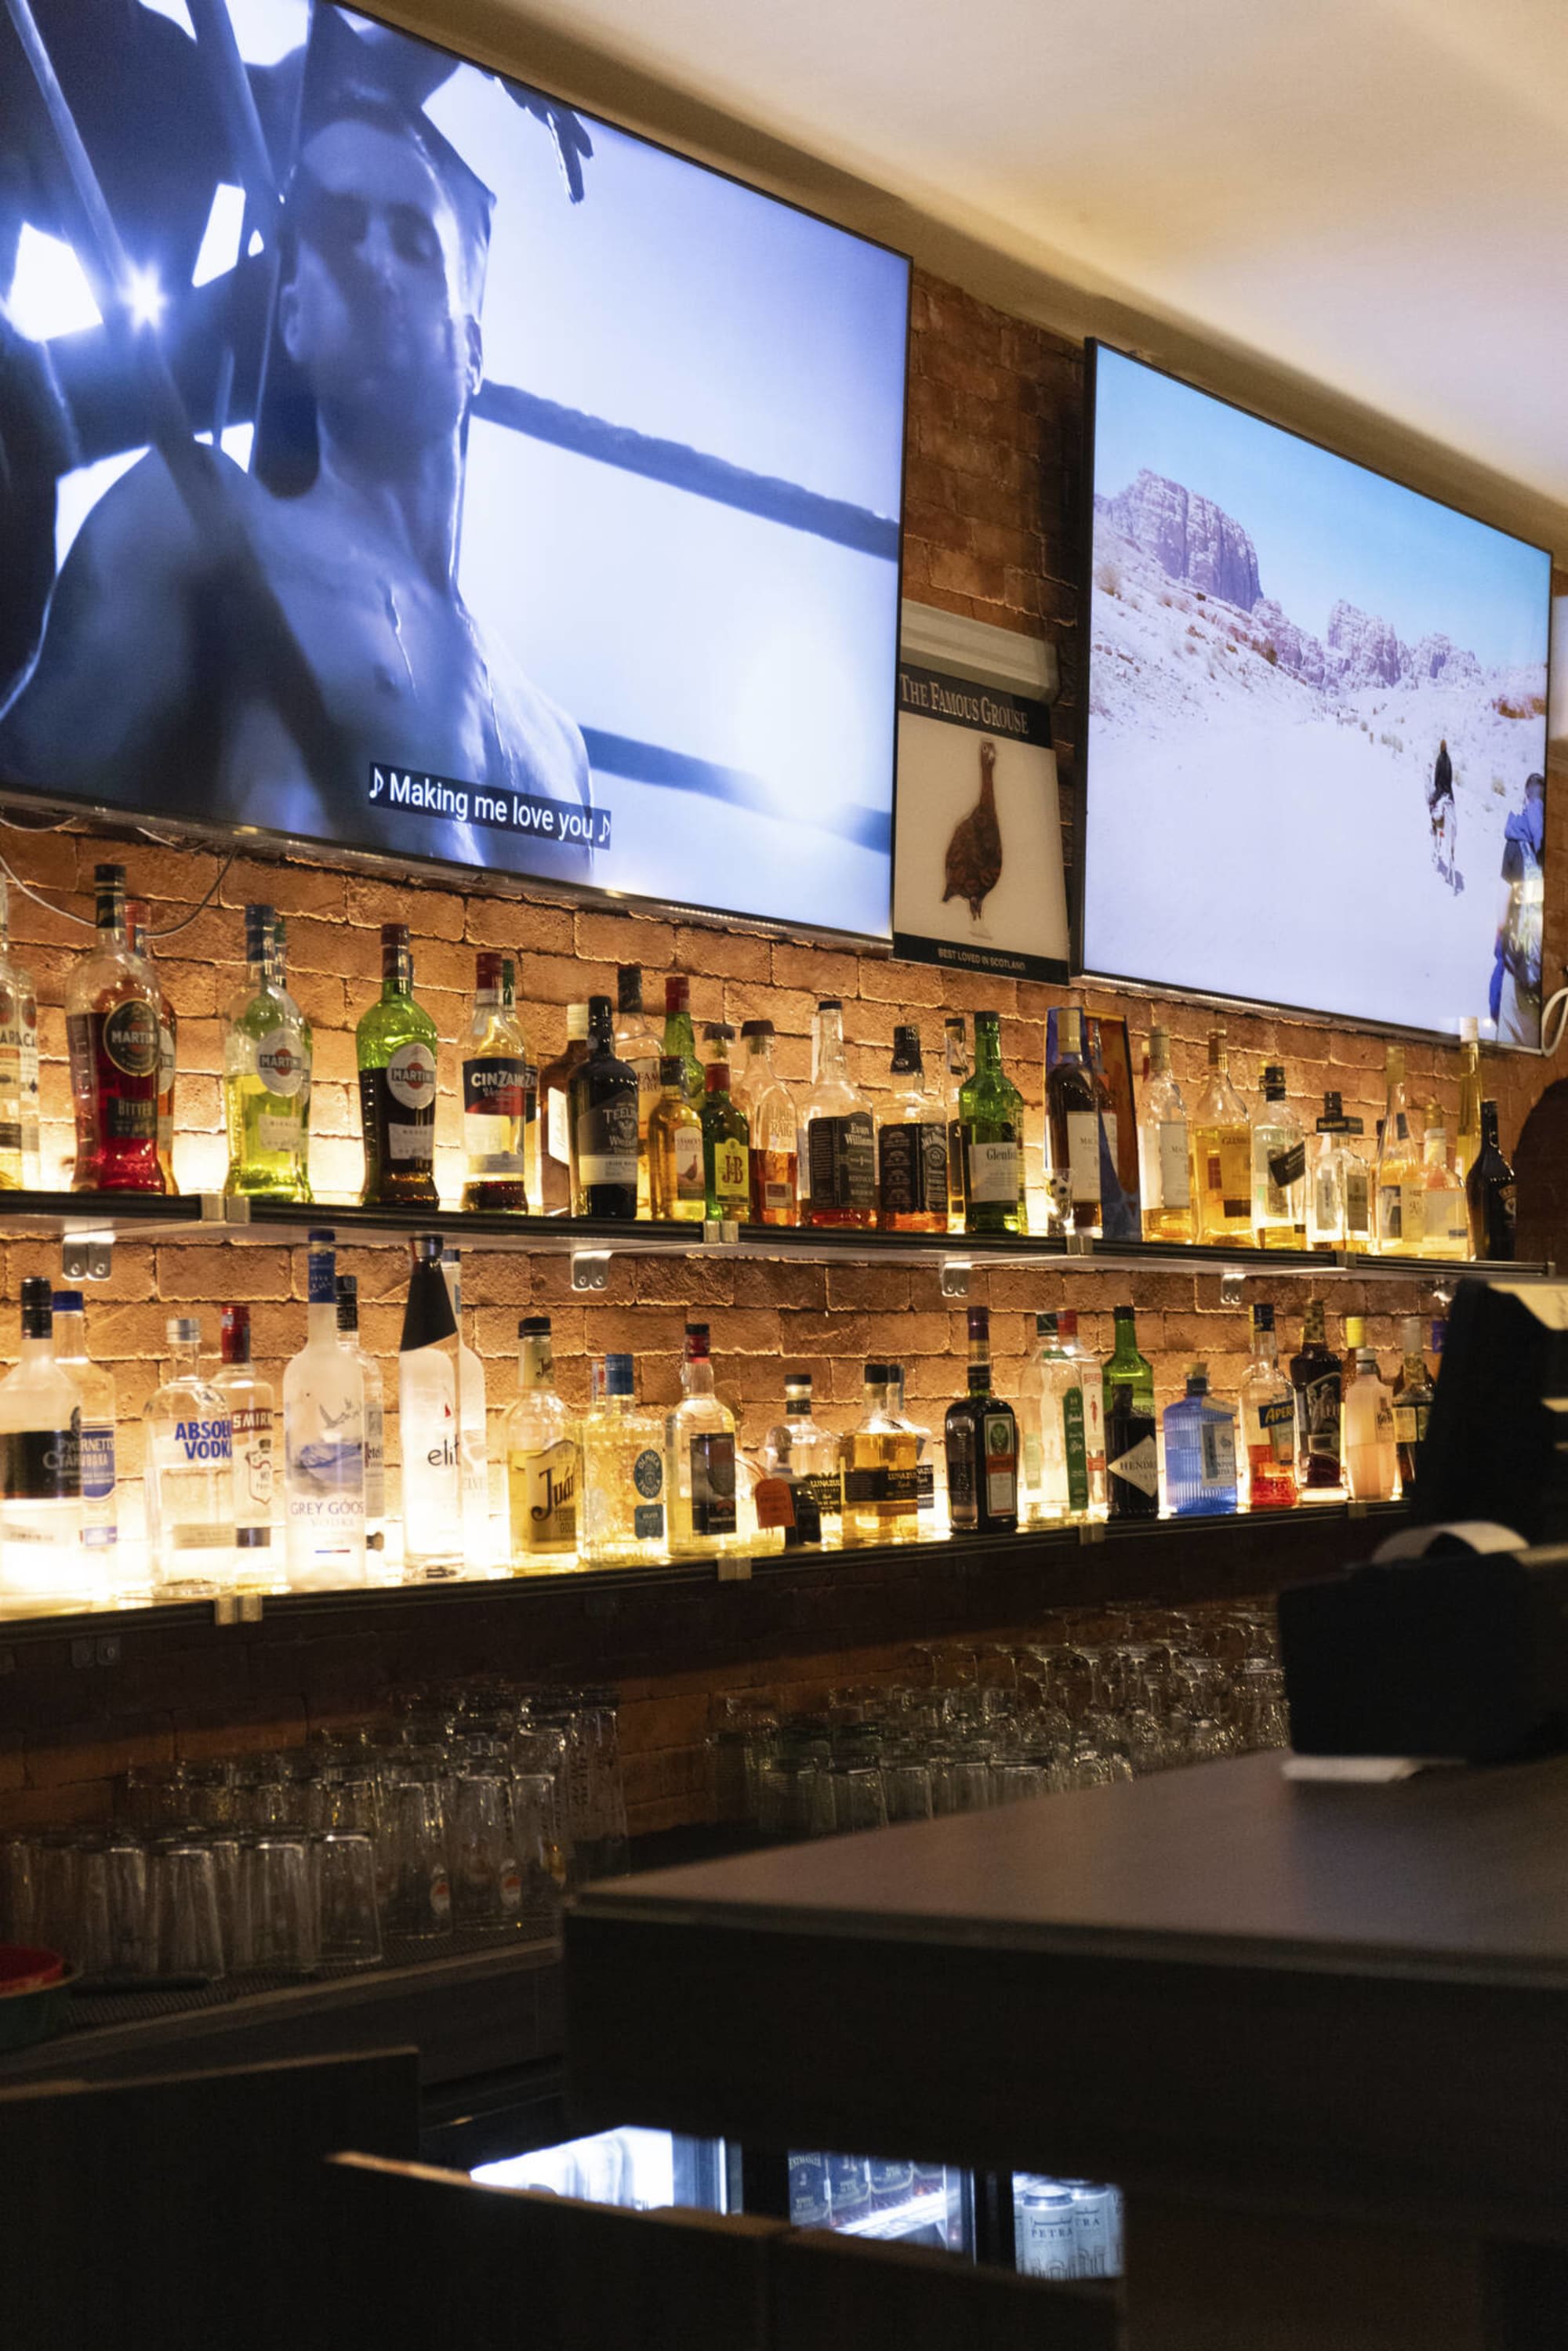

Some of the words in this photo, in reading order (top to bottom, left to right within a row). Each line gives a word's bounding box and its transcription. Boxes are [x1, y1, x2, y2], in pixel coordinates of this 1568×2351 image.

[900, 673, 928, 706] THE
[930, 680, 979, 722] FAMOUS
[981, 696, 1029, 735] GROUSE
[390, 772, 469, 822] Making
[474, 795, 507, 822] me
[513, 796, 554, 832] love
[557, 811, 593, 841] you
[938, 947, 956, 960] BEST
[957, 951, 981, 964] LOVED
[982, 955, 989, 966] IN
[990, 956, 1025, 971] SCOTLAND
[427, 1434, 460, 1467] elit
[290, 1501, 324, 1515] GREY
[1031, 2228, 1073, 2239] PETRA
